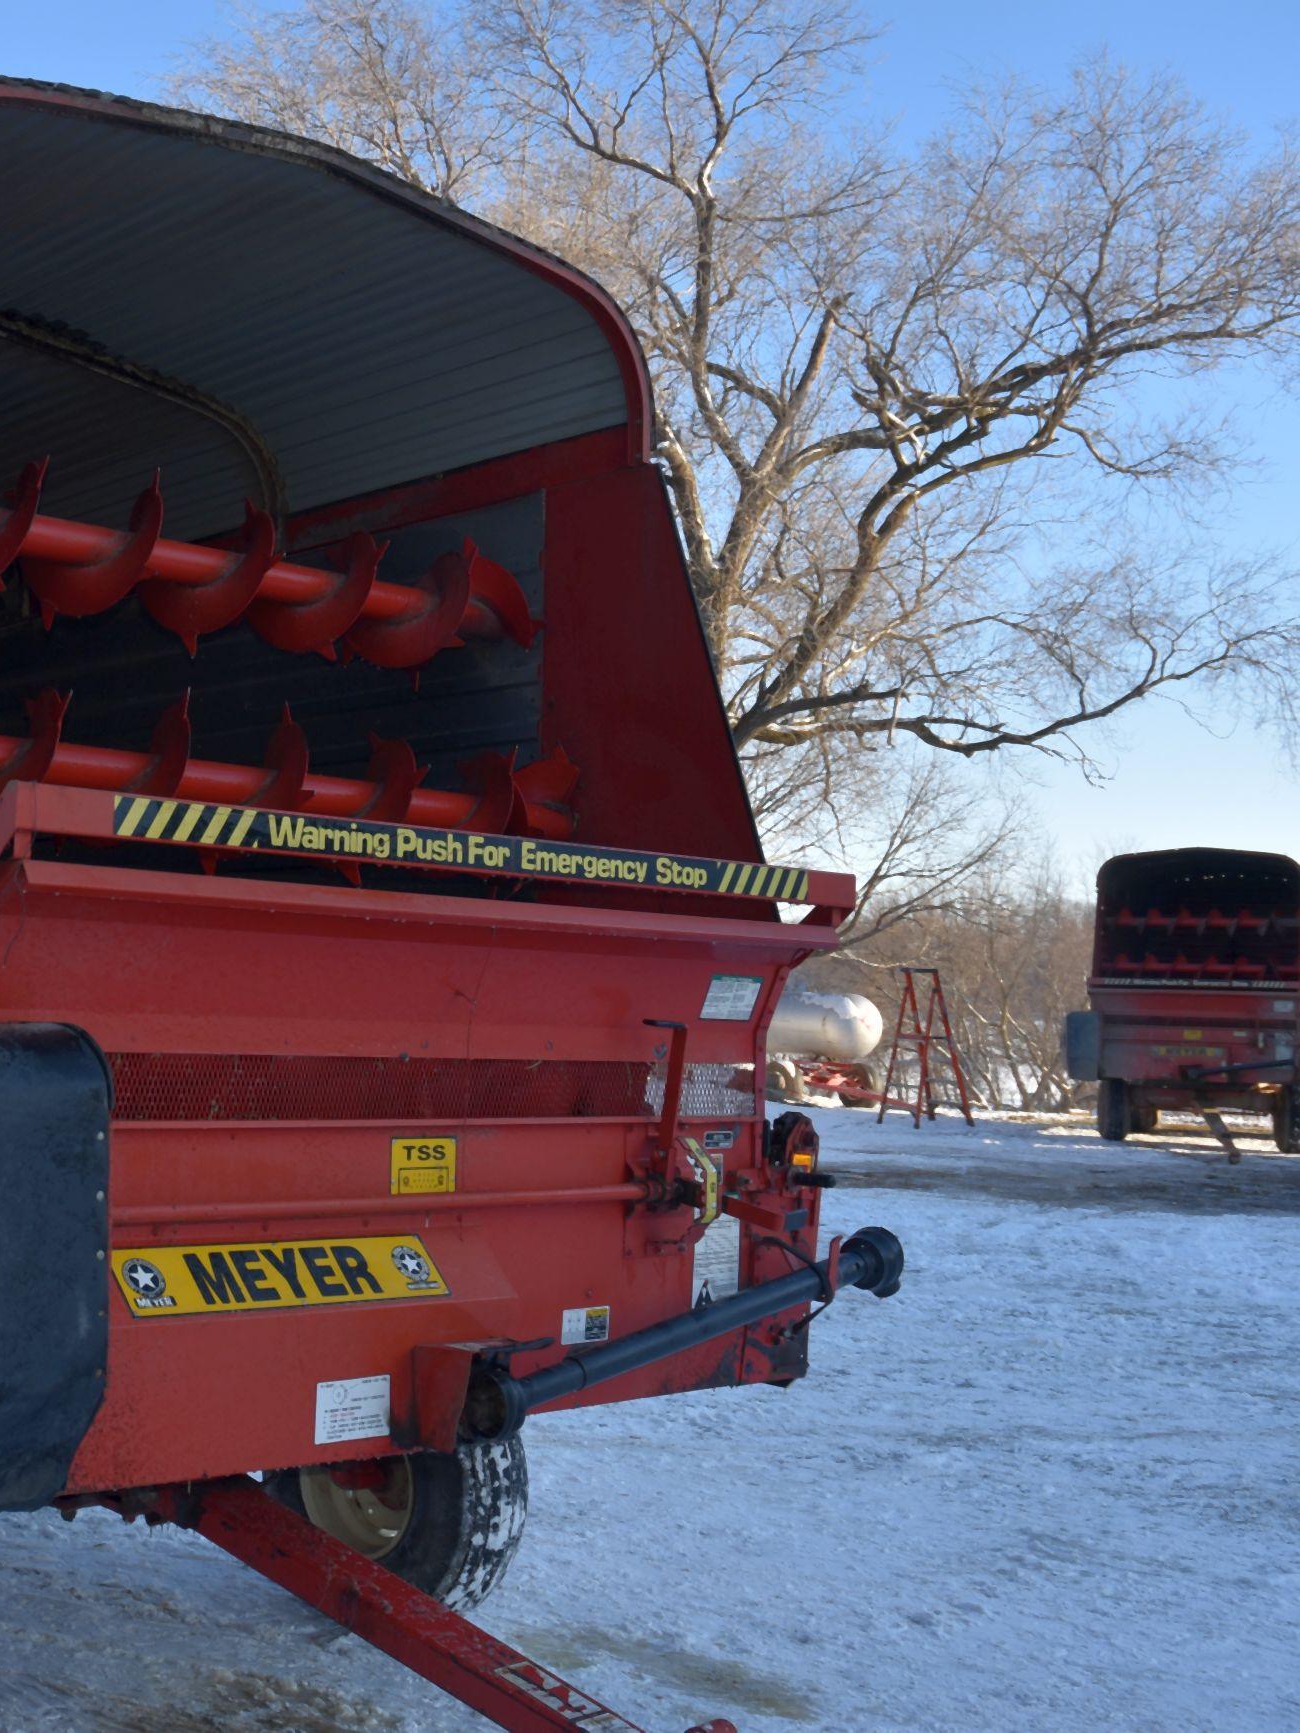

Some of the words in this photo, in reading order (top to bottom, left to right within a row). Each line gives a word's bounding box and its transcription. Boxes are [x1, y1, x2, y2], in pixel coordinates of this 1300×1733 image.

[268, 814, 390, 858] Warning
[397, 828, 462, 863] Push
[468, 835, 510, 867] For
[521, 841, 647, 882] Emergency
[656, 857, 708, 888] Stop
[402, 1145, 445, 1161] TSS
[182, 1246, 383, 1304] MEYER
